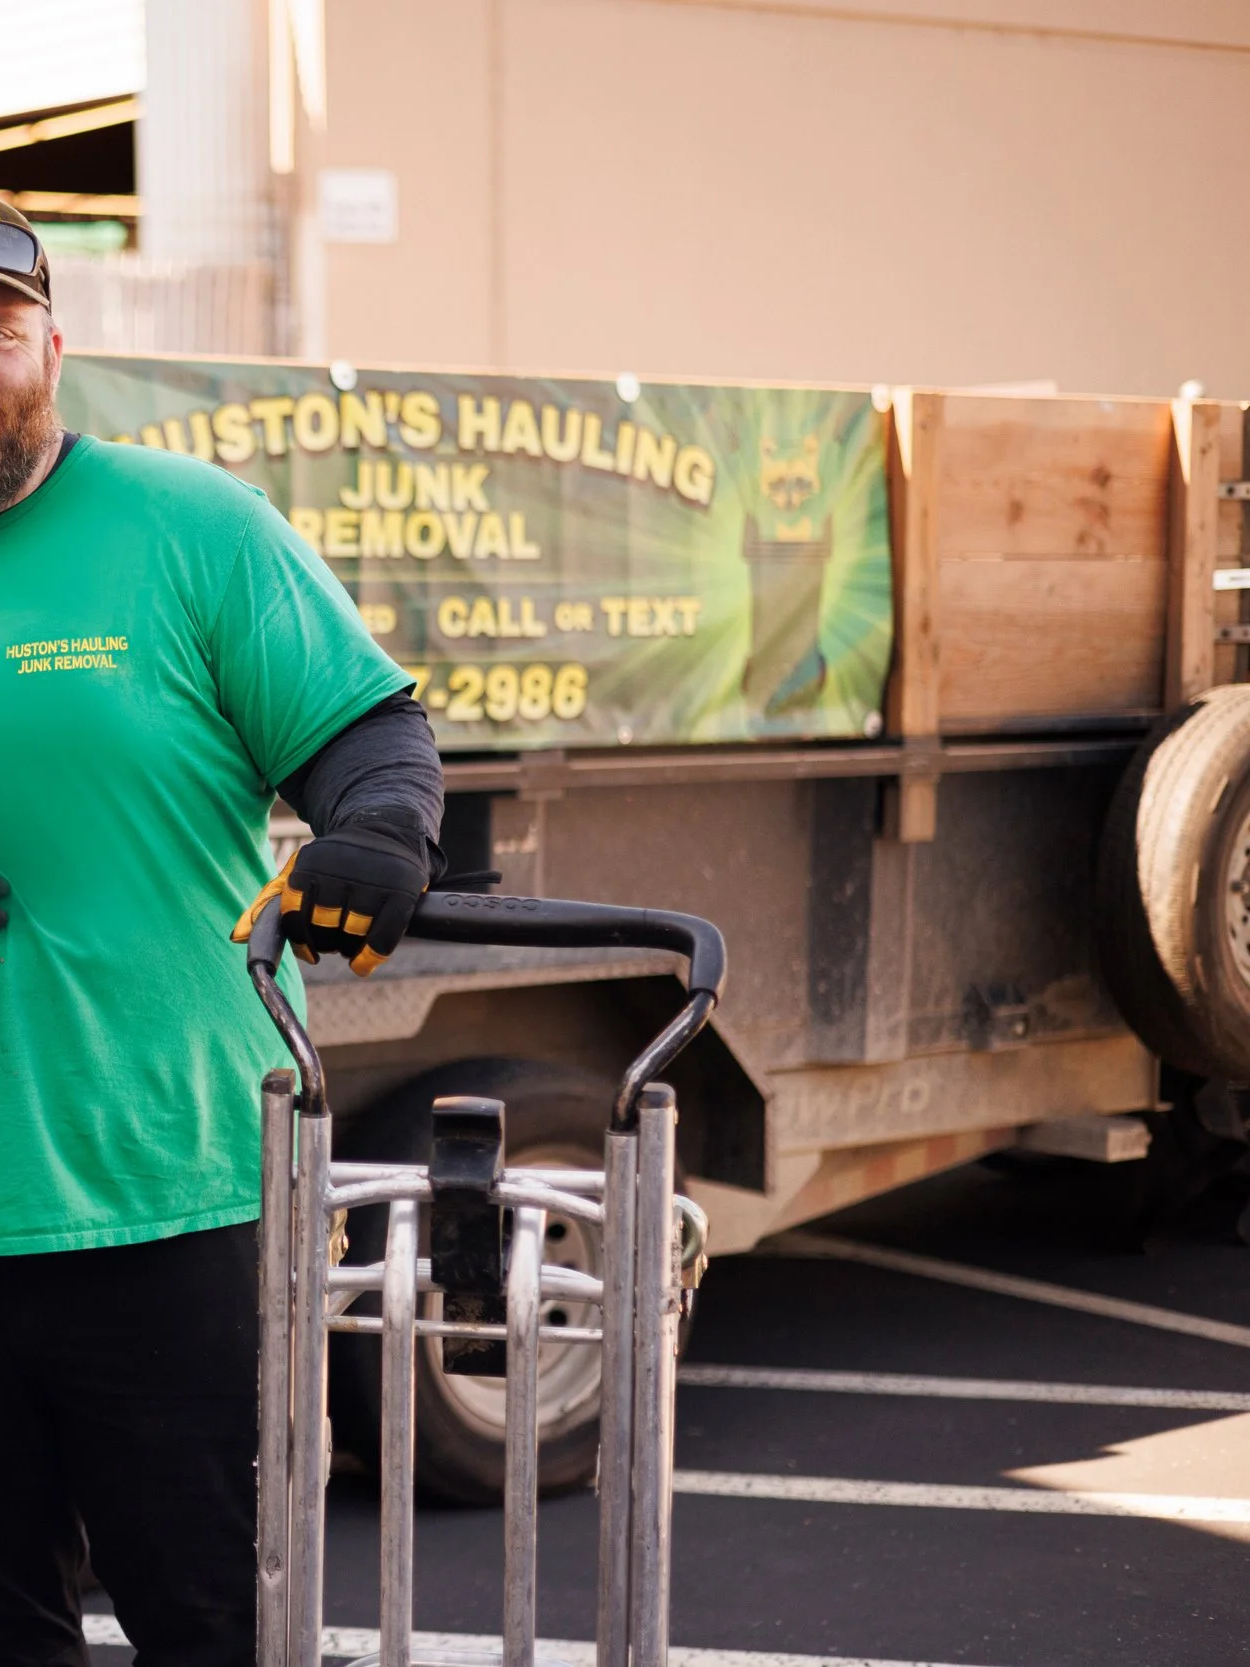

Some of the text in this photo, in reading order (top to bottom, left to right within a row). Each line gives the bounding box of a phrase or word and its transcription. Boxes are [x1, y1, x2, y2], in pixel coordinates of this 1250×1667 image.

[112, 390, 716, 507] USTON'S HAULING
[339, 460, 490, 512] JUNK
[289, 507, 541, 560] REMOVAL
[437, 596, 548, 638] CALL
[554, 602, 594, 632] OR
[602, 597, 701, 636] TEXT
[6, 636, 128, 659] HUSTON'S HAULING
[17, 654, 117, 674] JUNK REMOVAL
